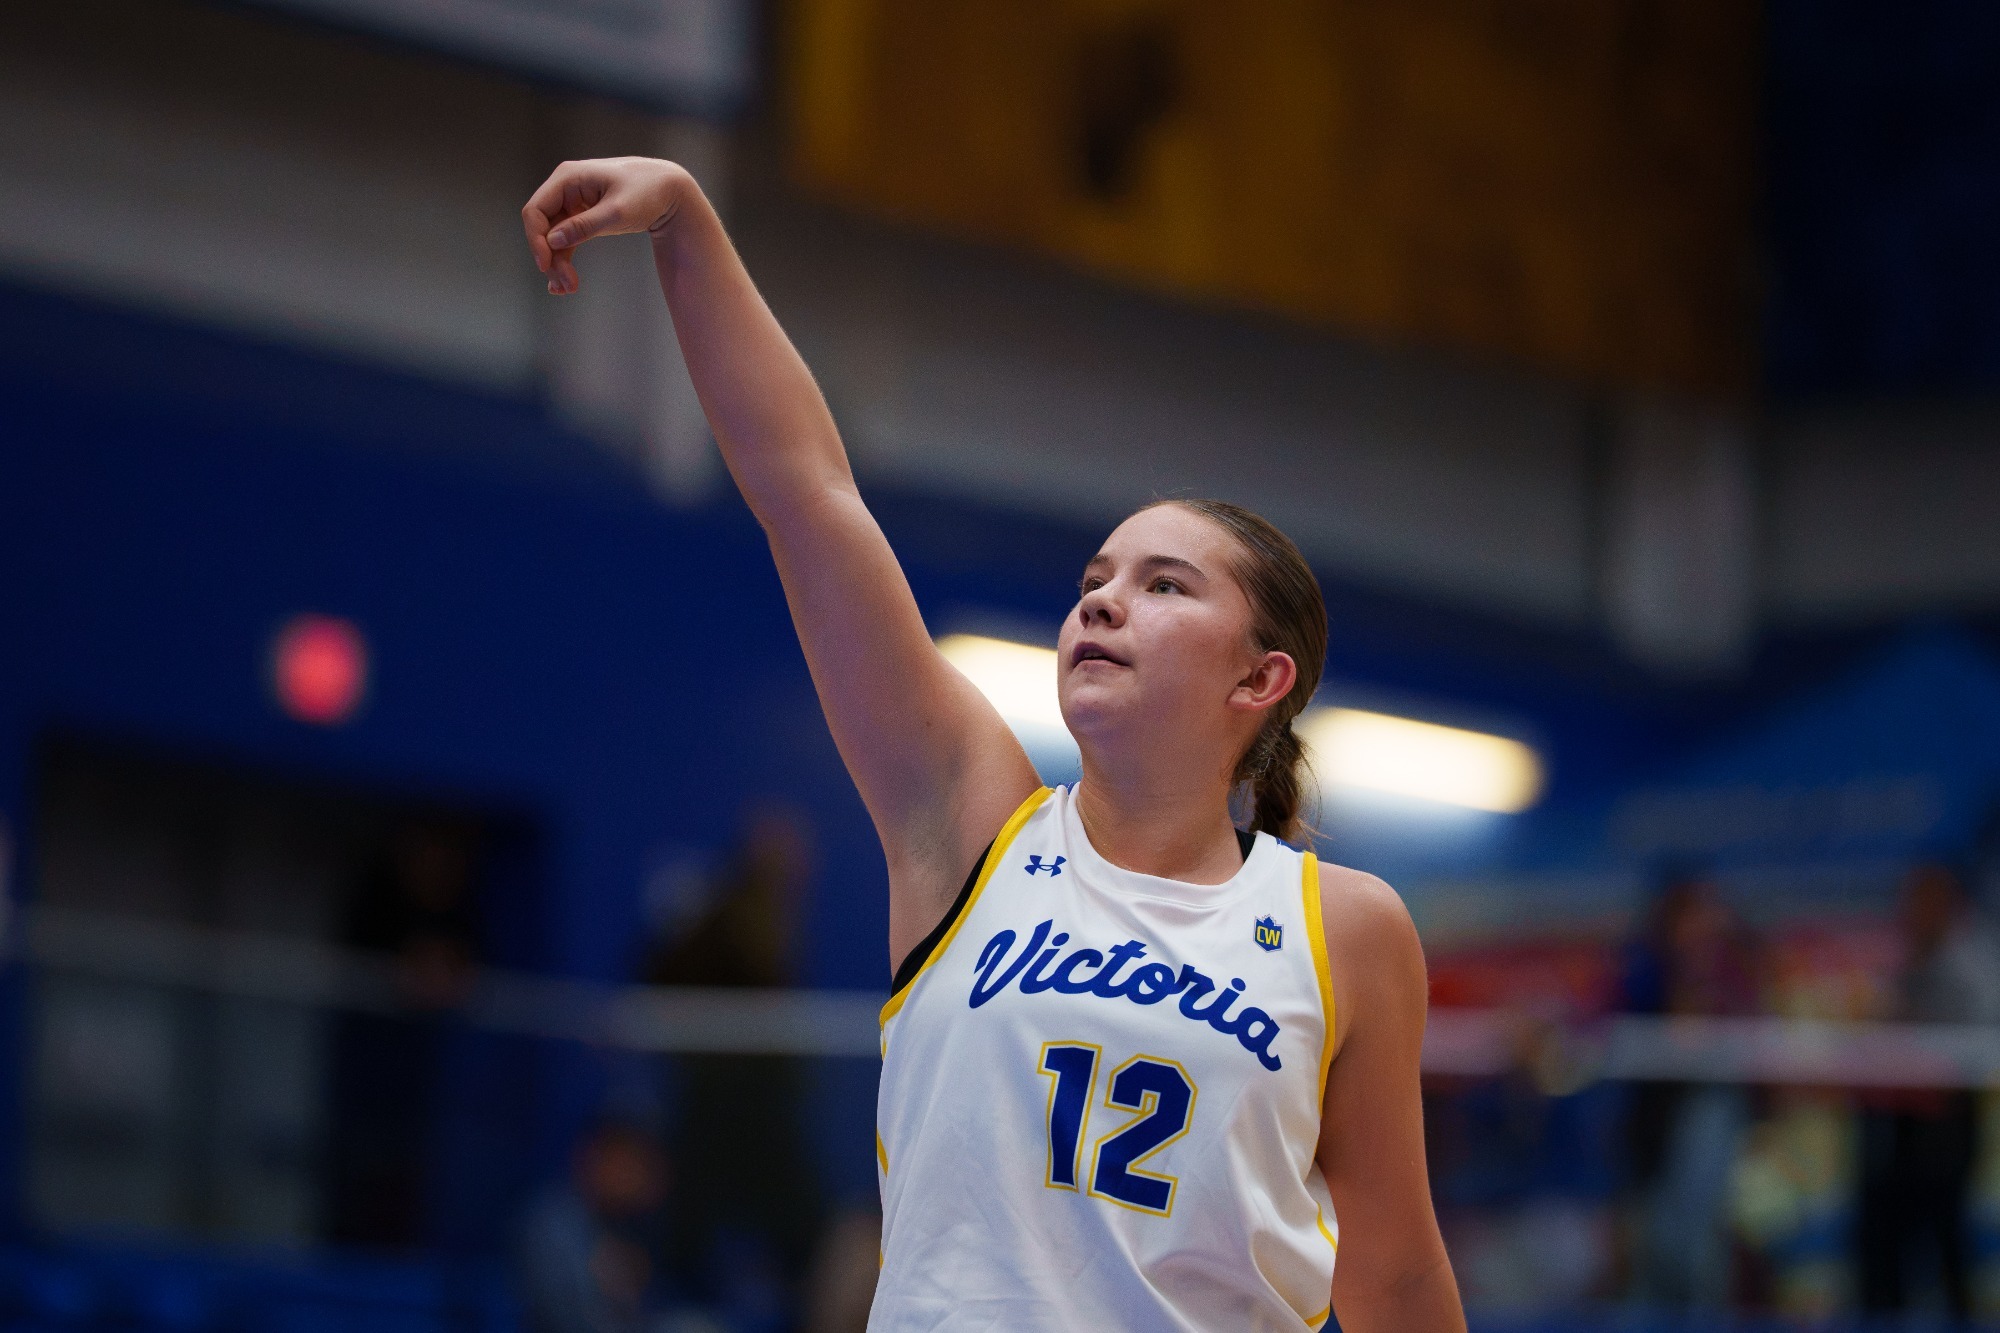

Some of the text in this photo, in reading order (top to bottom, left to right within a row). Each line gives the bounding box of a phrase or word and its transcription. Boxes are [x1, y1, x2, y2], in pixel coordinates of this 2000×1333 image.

[968, 919, 1282, 1072] Victoria
[1256, 925, 1281, 947] CW
[1037, 1040, 1198, 1218] 12
